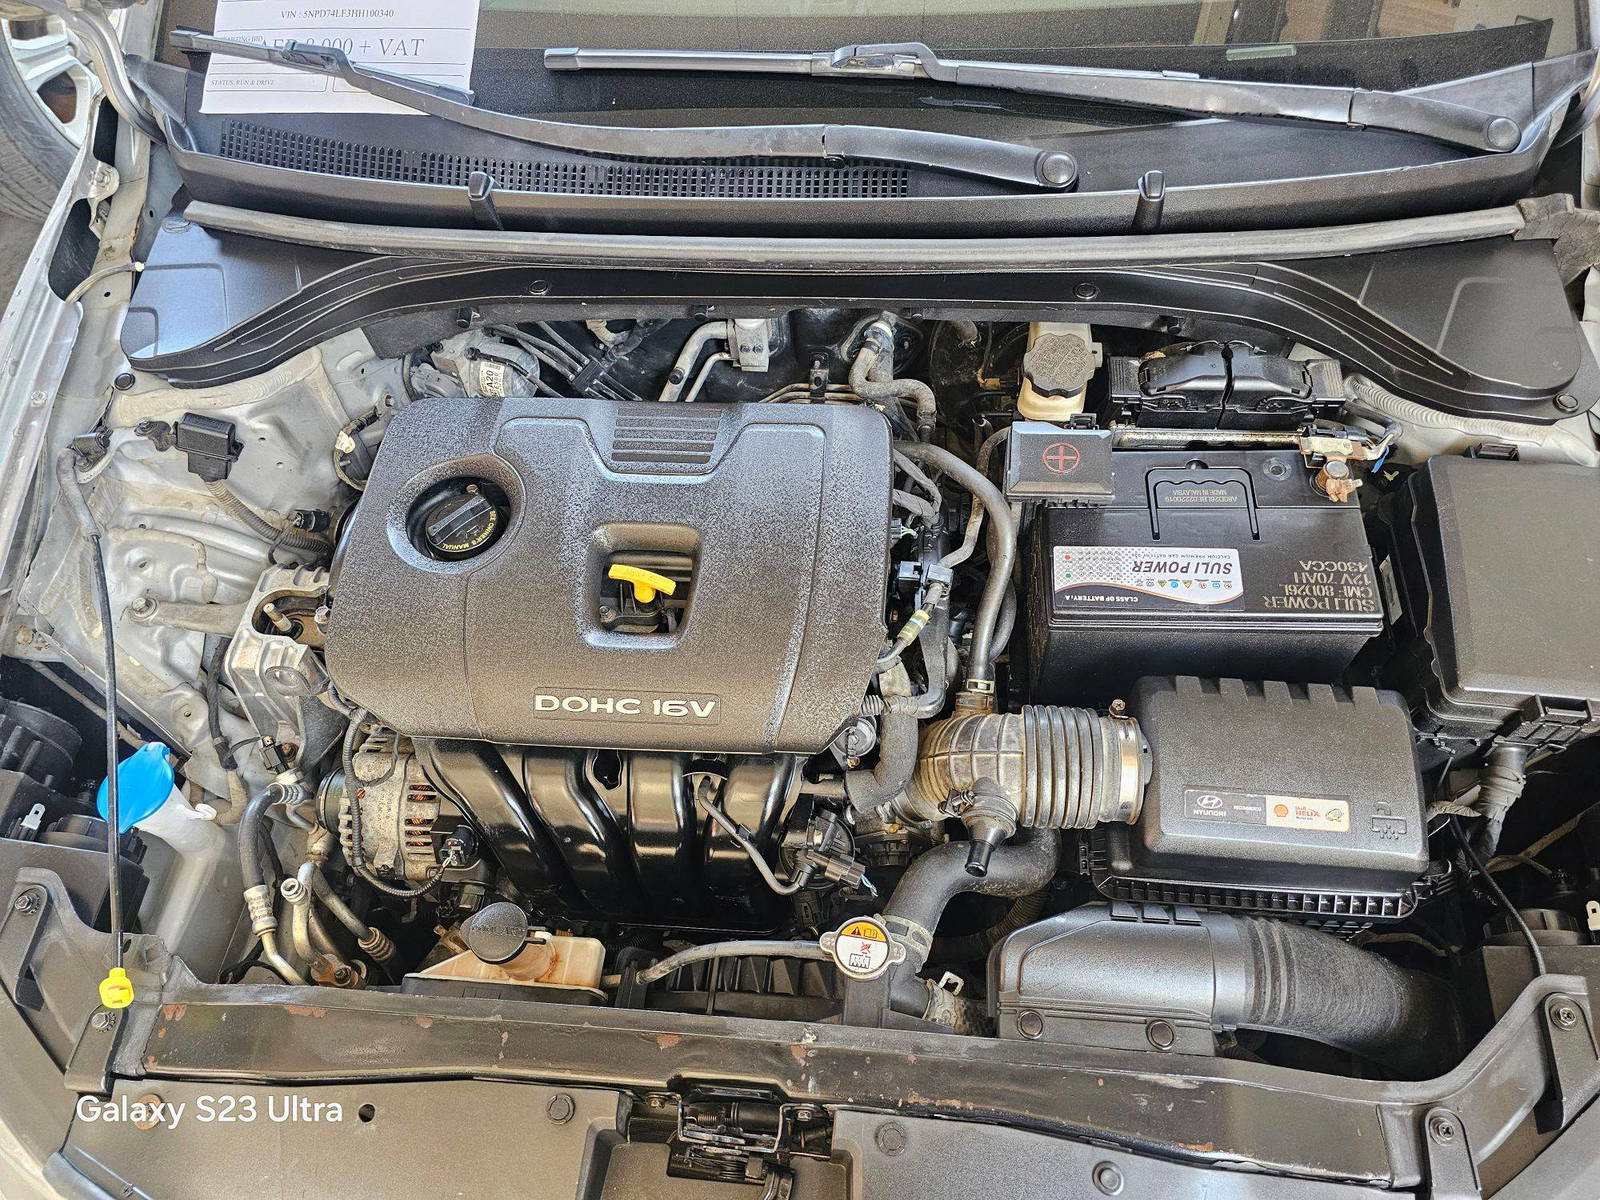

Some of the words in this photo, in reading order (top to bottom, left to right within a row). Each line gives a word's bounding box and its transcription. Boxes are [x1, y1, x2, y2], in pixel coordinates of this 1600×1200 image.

[281, 10, 297, 19] VIN
[379, 38, 424, 56] VAT
[442, 542, 469, 550] MANUAL
[1132, 560, 1191, 574] POWER
[1194, 561, 1233, 575] SULI
[1299, 560, 1369, 573] 430CCA
[1293, 571, 1337, 584] 70AH
[1340, 573, 1372, 586] 12V
[1262, 595, 1331, 610] POWER
[535, 694, 641, 715] DOHC
[652, 699, 716, 718] 16V
[1193, 809, 1227, 817] HYUNDAI
